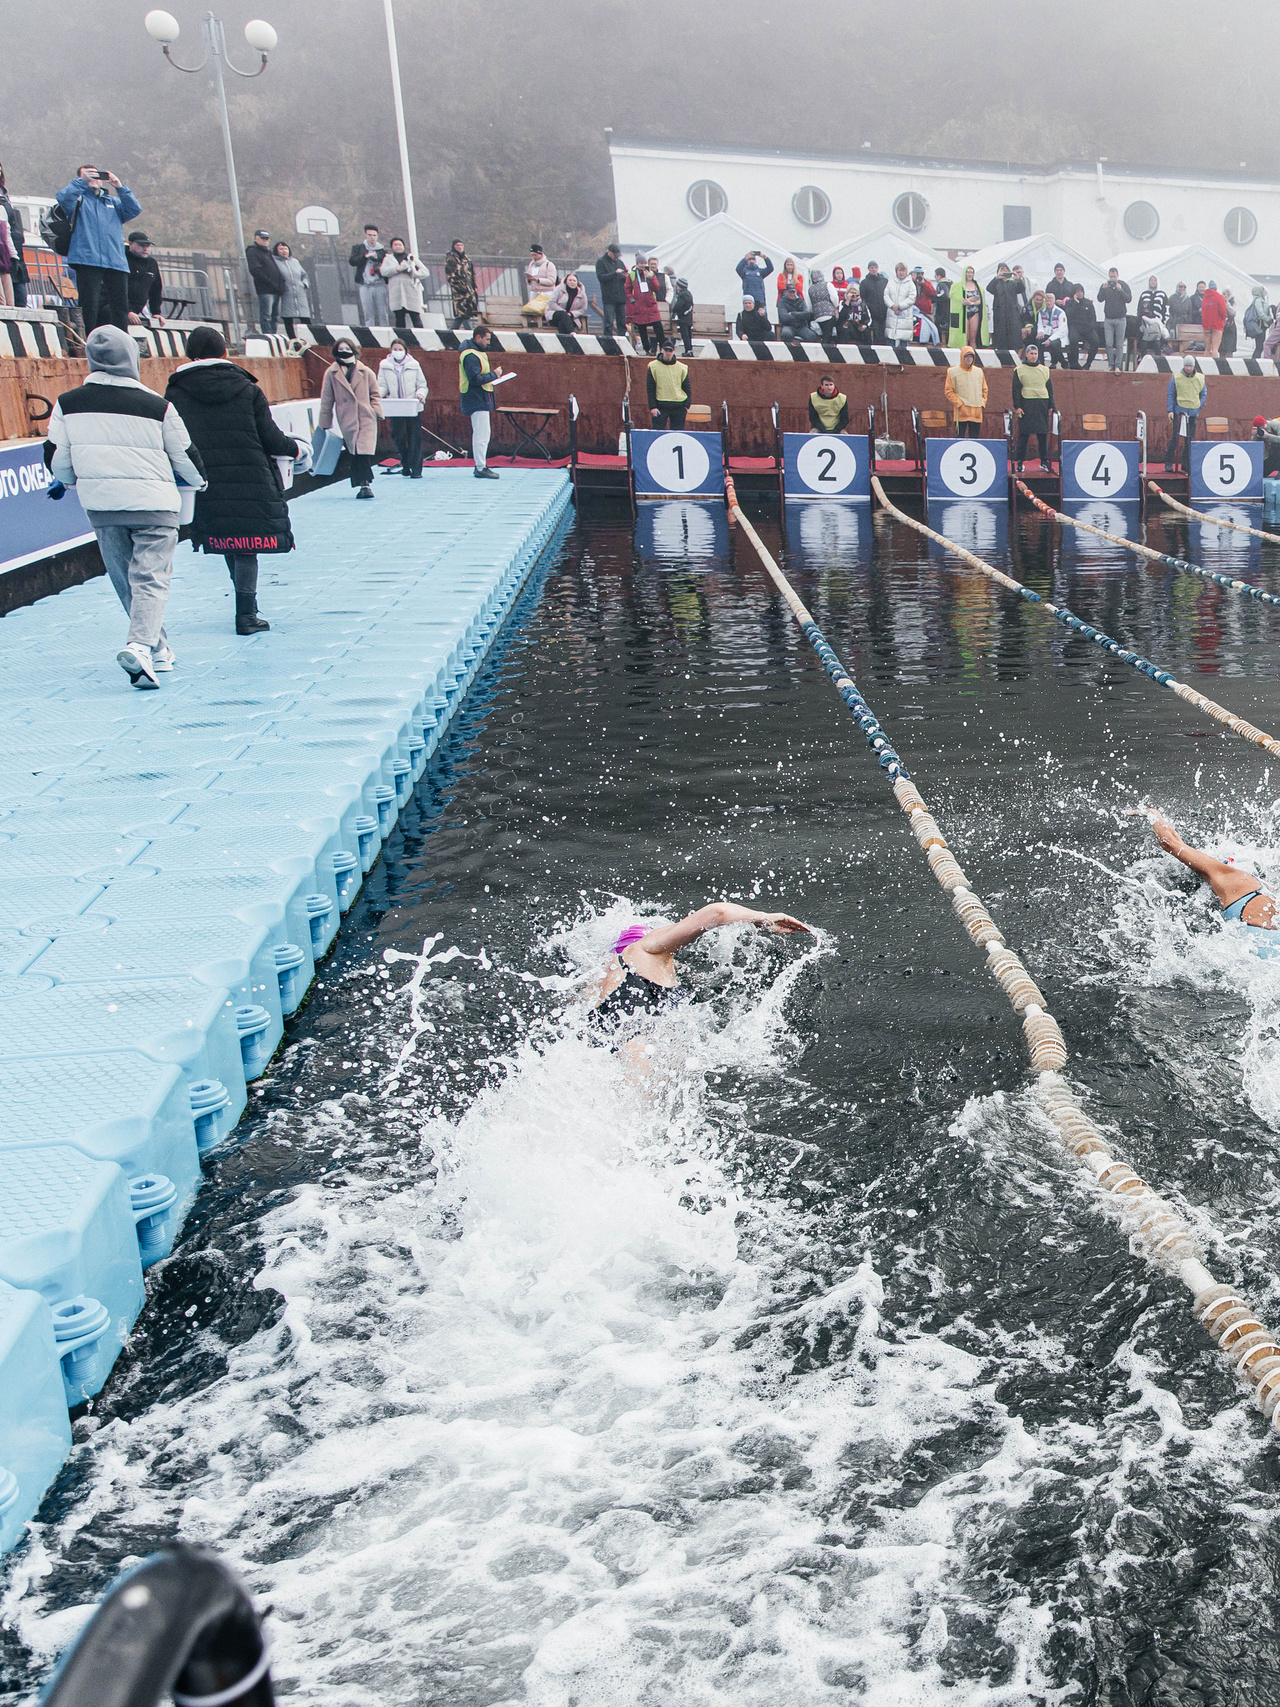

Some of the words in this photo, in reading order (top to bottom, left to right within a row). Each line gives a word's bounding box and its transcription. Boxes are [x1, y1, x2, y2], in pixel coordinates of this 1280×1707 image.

[672, 445, 685, 480] 1
[816, 448, 838, 482] 2
[958, 452, 978, 485] 3
[1091, 454, 1112, 486] 4
[1218, 454, 1236, 486] 5
[0, 468, 19, 499] ГО
[19, 462, 55, 493] ОКЕА
[208, 535, 278, 550] FANGNIUBAN
